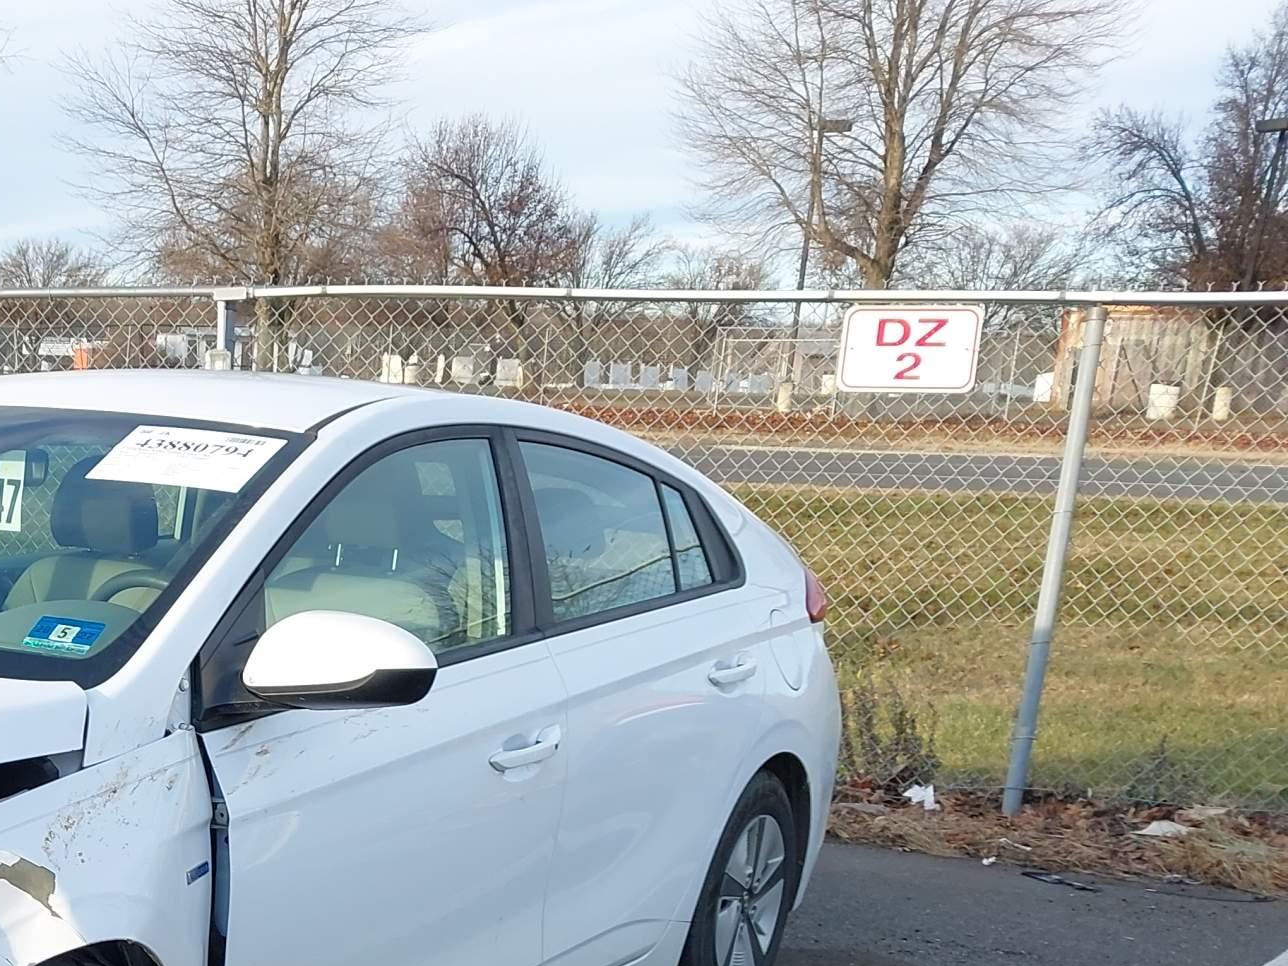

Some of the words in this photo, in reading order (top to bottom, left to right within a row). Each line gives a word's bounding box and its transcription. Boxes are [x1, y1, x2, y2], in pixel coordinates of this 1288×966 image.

[875, 318, 949, 347] DZ
[893, 352, 923, 380] 2
[135, 437, 257, 459] 43880794
[57, 627, 72, 639] 5
